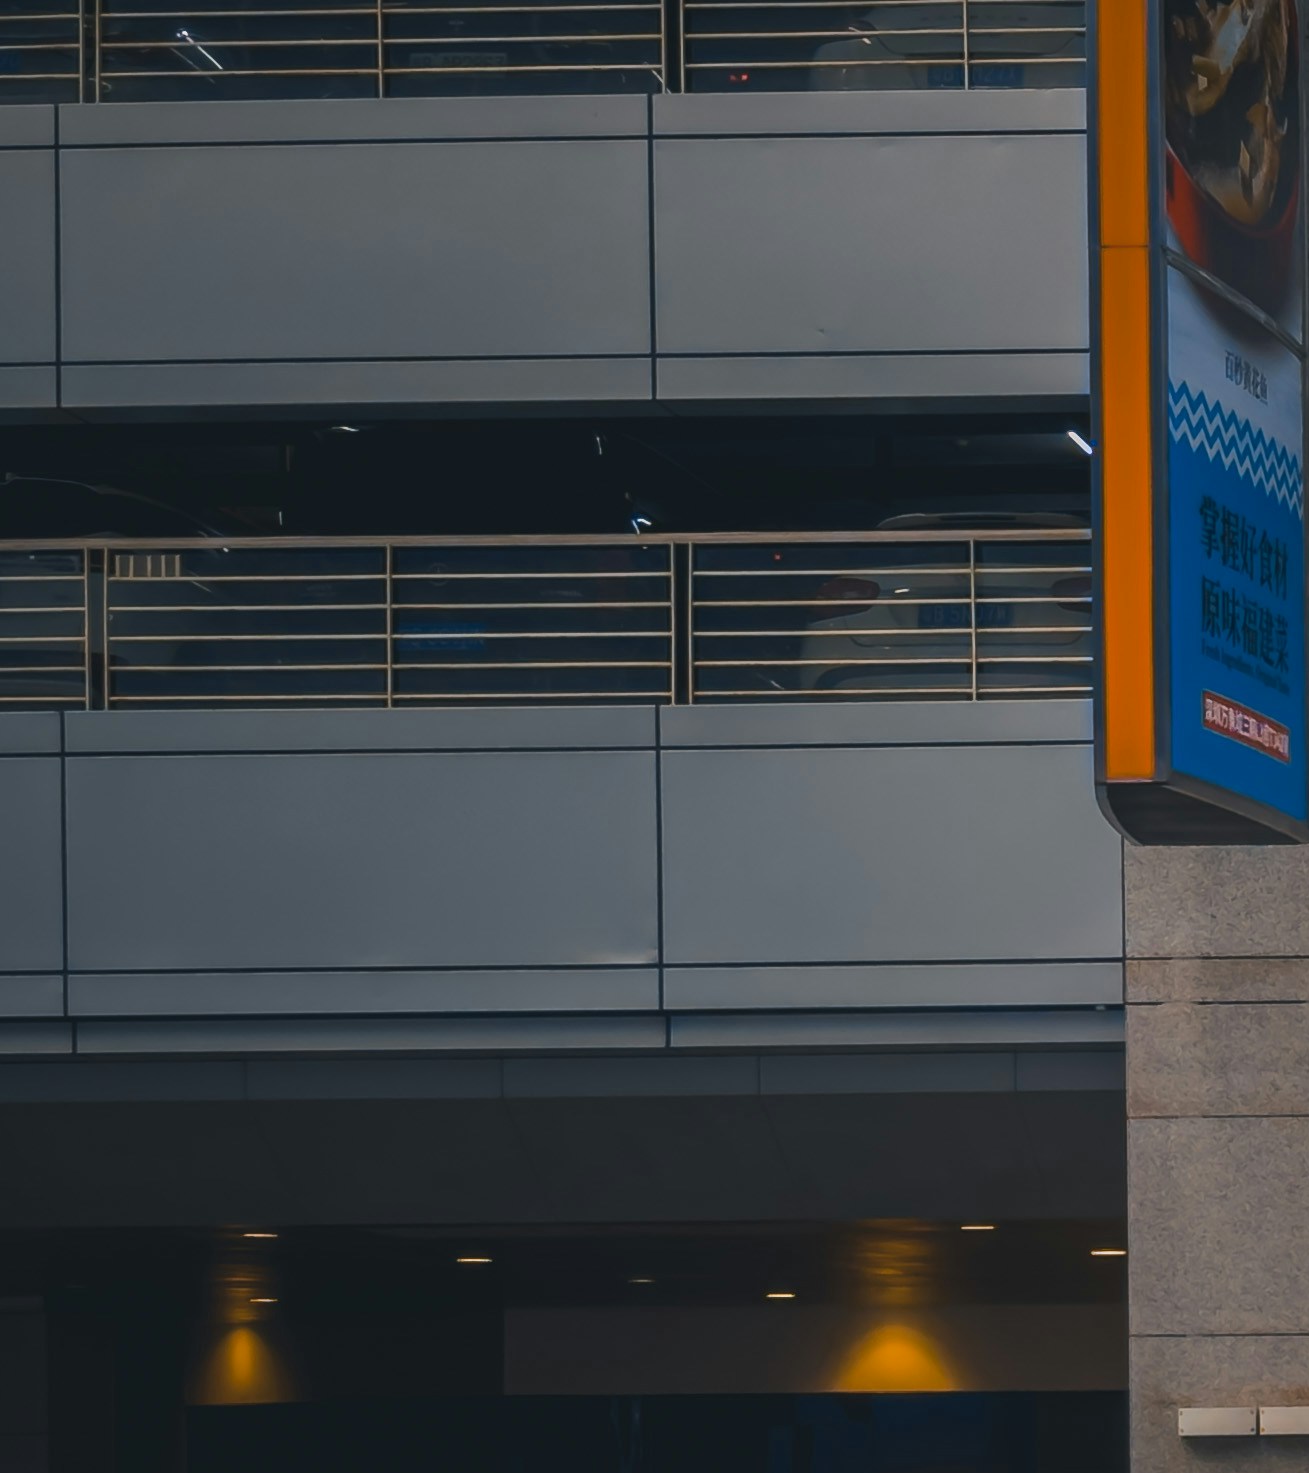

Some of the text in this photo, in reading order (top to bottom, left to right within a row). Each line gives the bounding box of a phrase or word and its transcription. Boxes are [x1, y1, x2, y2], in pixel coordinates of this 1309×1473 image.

[1199, 495, 1289, 600] 掌握好食材
[1201, 575, 1290, 674] 原味福建菜
